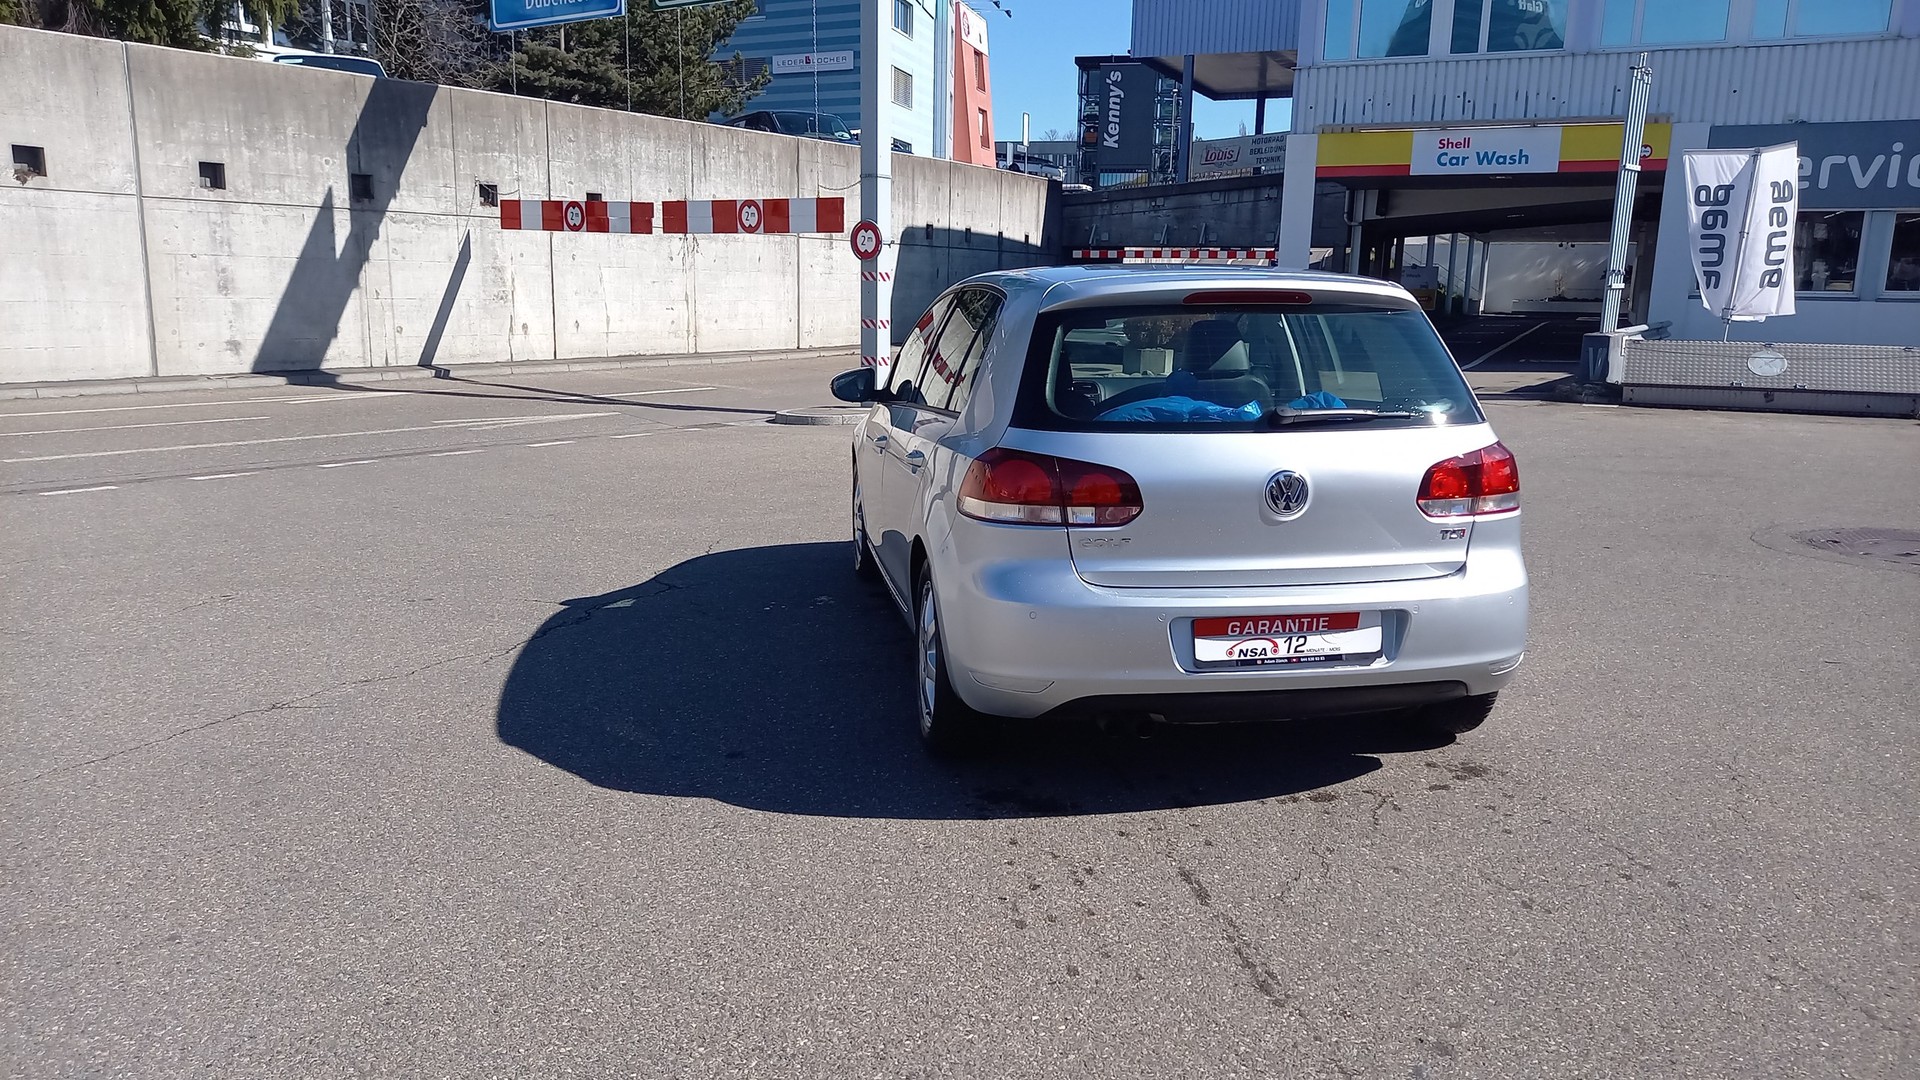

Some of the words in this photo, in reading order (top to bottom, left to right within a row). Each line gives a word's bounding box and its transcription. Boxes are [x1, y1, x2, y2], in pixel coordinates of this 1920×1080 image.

[776, 58, 804, 67] LEDER
[812, 55, 847, 65] LOCHER
[1103, 70, 1125, 148] Kenny's
[1438, 136, 1471, 150] Shell
[1204, 147, 1235, 163] Louis
[1255, 155, 1282, 165] TECHNIK
[1436, 151, 1470, 167] Car
[1475, 148, 1530, 166] Wash
[1079, 537, 1132, 550] GOLF
[1227, 617, 1330, 636] GARANTIE
[1283, 635, 1308, 654] 12
[1237, 647, 1268, 658] NSA
